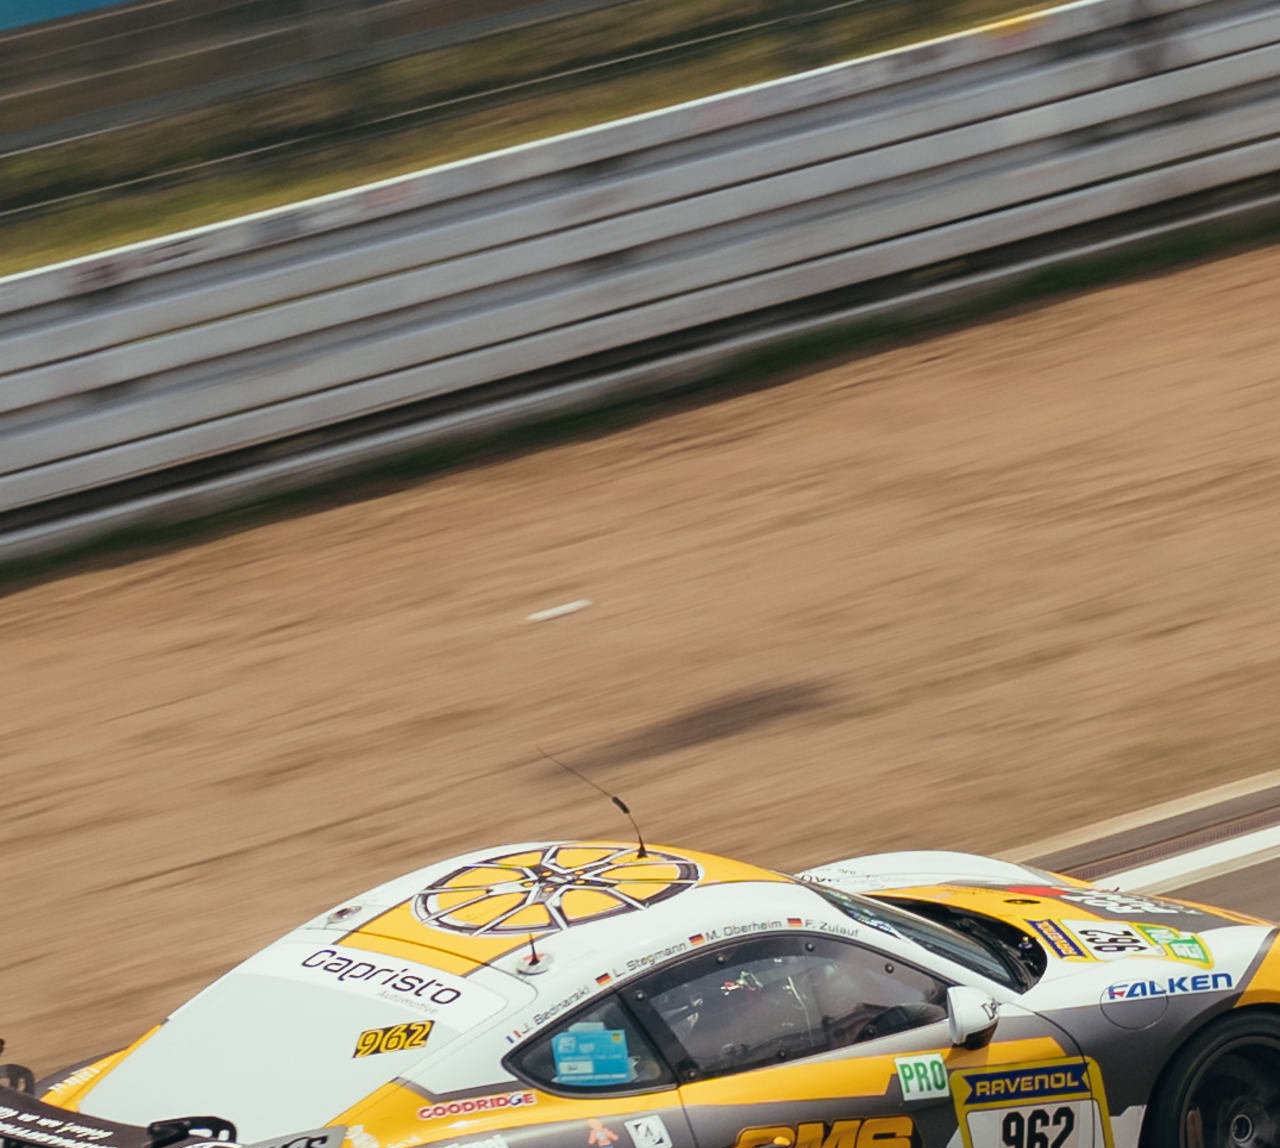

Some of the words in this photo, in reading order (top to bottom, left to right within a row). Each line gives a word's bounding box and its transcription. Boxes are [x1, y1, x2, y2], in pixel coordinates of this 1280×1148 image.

[820, 922, 859, 937] Zulauf
[1078, 929, 1148, 953] 962
[301, 949, 462, 1005] Capristo
[1108, 973, 1233, 1000] FALKEN
[354, 1020, 433, 1058] 962
[899, 1060, 947, 1093] PRO
[976, 1071, 1079, 1097] RAVENOL
[418, 1091, 537, 1120] GOODRIDGE
